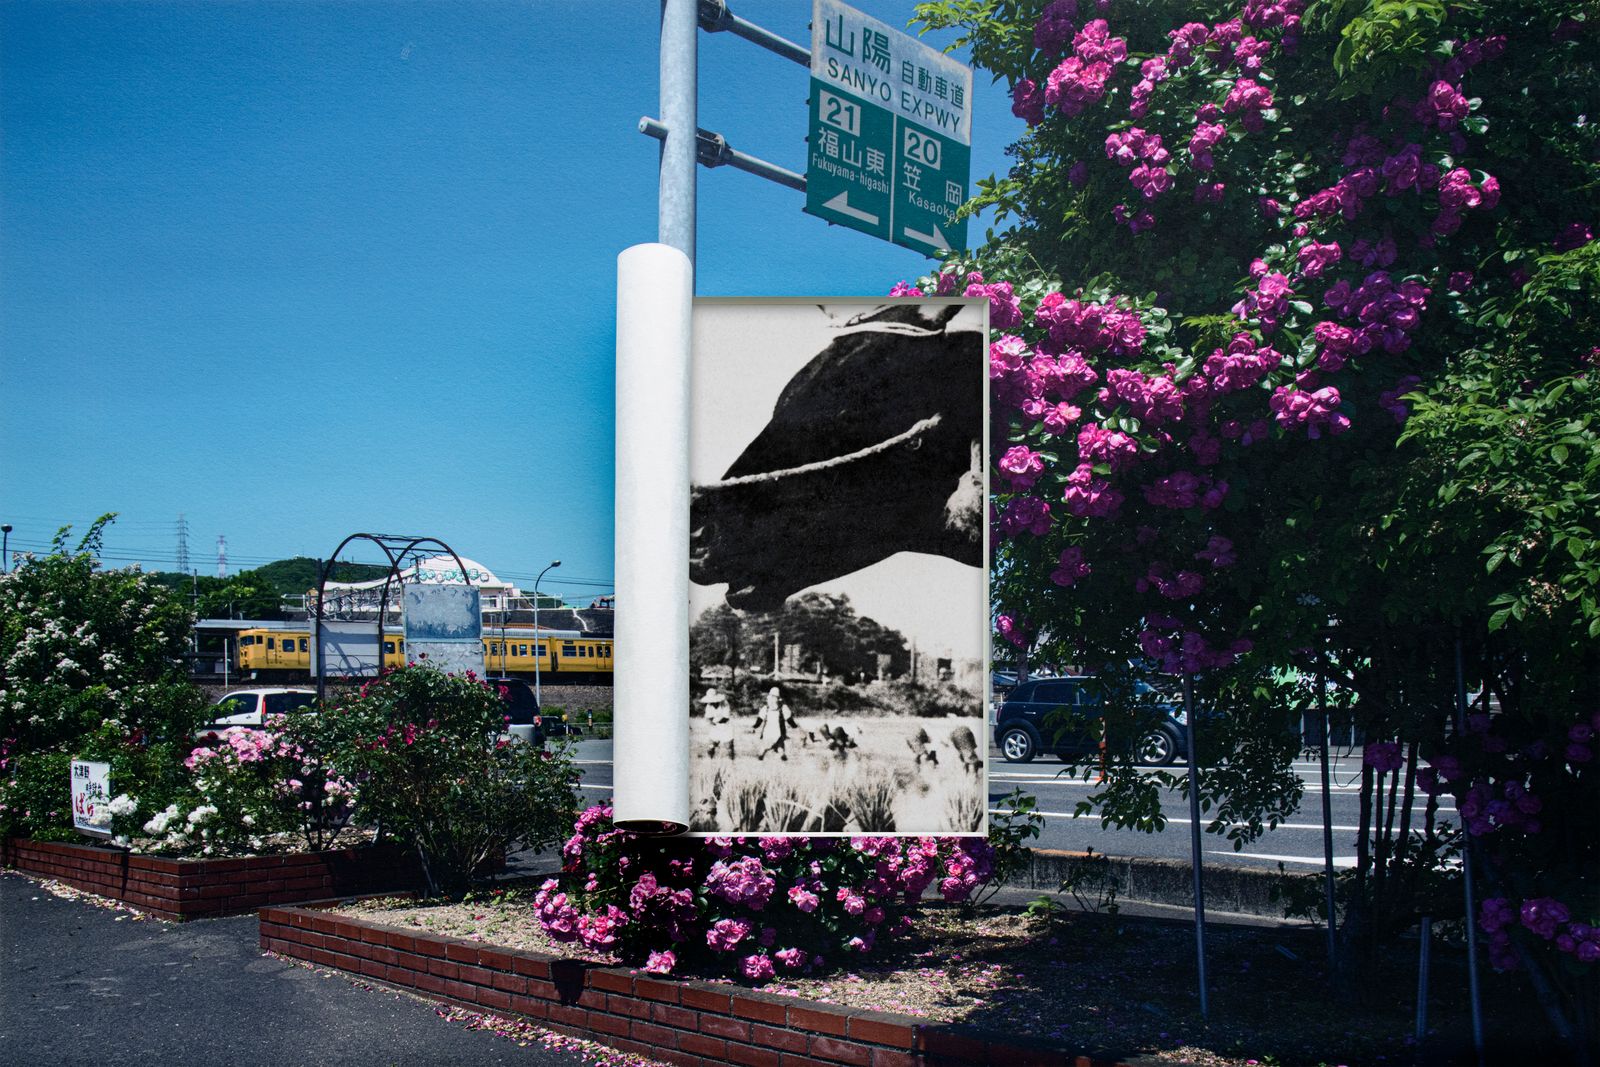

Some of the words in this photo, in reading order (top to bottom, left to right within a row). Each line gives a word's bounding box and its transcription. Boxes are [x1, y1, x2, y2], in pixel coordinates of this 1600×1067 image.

[825, 14, 892, 75] 山陽
[901, 60, 965, 111] 自動車道
[826, 97, 854, 131] 21
[827, 57, 892, 102] SANYO
[901, 91, 961, 134] EXPWY
[817, 127, 887, 177] 福山東
[907, 132, 938, 166] 20
[812, 153, 889, 195] Fukuyama-higashi
[908, 191, 956, 220] Kasaoka
